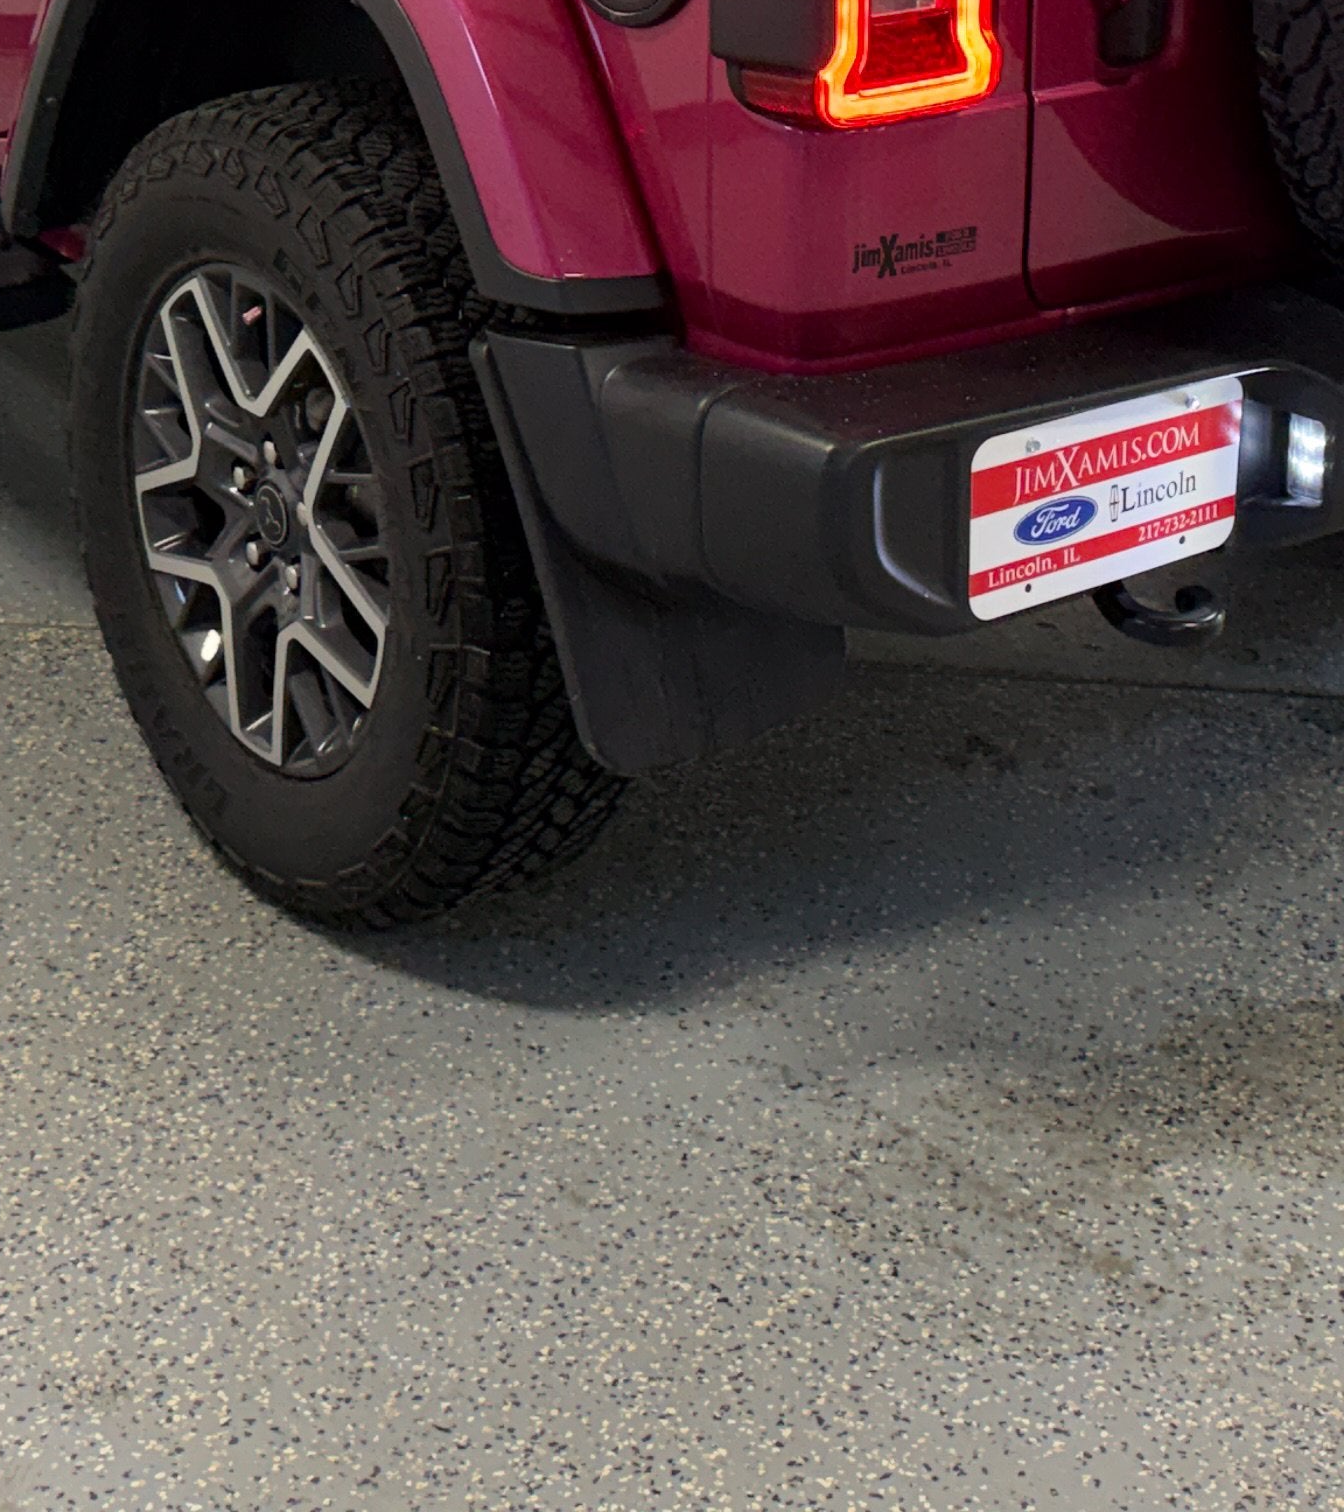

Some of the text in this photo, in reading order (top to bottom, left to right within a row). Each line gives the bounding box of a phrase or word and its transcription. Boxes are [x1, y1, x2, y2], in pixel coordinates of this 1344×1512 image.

[1121, 470, 1197, 513] Lincoln
[1031, 504, 1081, 540] Ford
[1138, 505, 1219, 544] 217-732-2111
[988, 547, 1081, 589] Lincoln, IL
